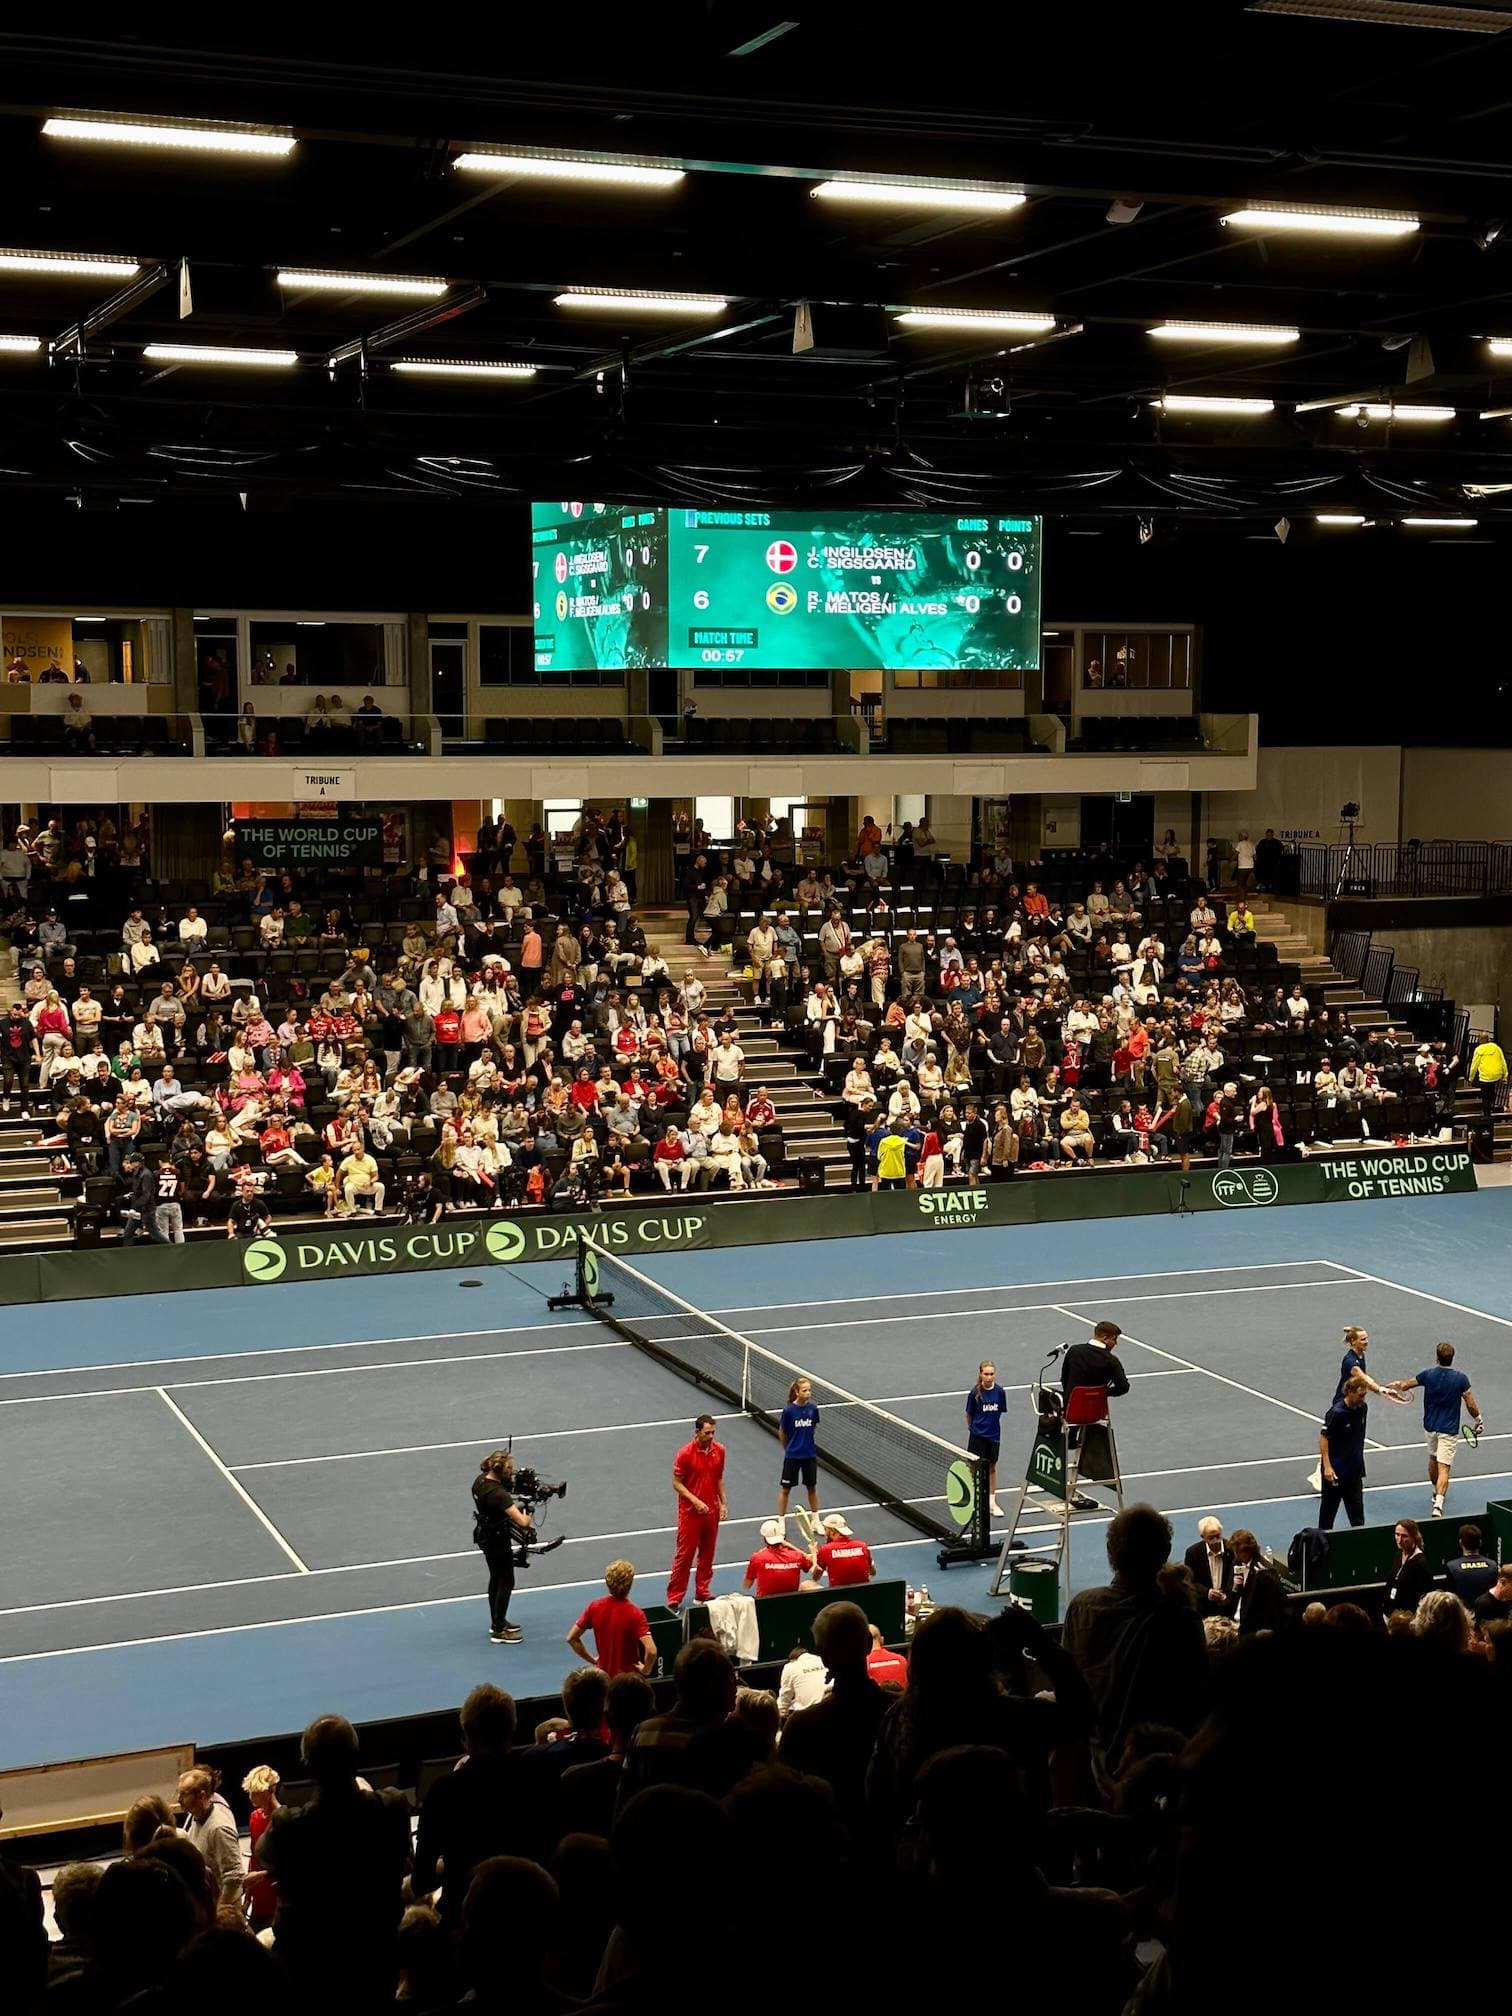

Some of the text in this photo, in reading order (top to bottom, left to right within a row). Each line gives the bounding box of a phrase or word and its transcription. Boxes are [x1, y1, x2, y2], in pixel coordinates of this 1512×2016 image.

[696, 511, 770, 526] PREVIOUS SETS
[957, 519, 989, 531] GAMES
[999, 520, 1033, 532] POINTS
[694, 545, 710, 564] 7
[966, 551, 981, 570] 0
[1007, 551, 1023, 570] 0
[826, 558, 916, 570] SIGSGAARD
[694, 591, 710, 610] 6
[826, 591, 881, 603] MATOS
[825, 602, 896, 615] MELIGENI
[896, 603, 948, 615] ALVES
[1006, 595, 1022, 614] 0
[695, 632, 754, 644] MATCH TIME
[702, 649, 745, 662] 00:57
[305, 775, 340, 786] TRIBUNE
[320, 787, 326, 796] A
[241, 827, 378, 842] THE WORLD CUP
[1280, 830, 1320, 839] TRIBUNE A
[263, 845, 287, 858] OF
[1320, 1154, 1470, 1179] THE WORLD CUP
[158, 1179, 178, 1197] 27
[1218, 1185, 1235, 1196] ITF
[1348, 1180, 1373, 1198] OF
[918, 1189, 988, 1213] STATE
[933, 1213, 977, 1225] ENERGY
[536, 1221, 629, 1250] DAVIS
[299, 1237, 397, 1268] DAVIS
[1036, 1452, 1055, 1474] ITF
[1461, 1561, 1489, 1570] BRASIL
